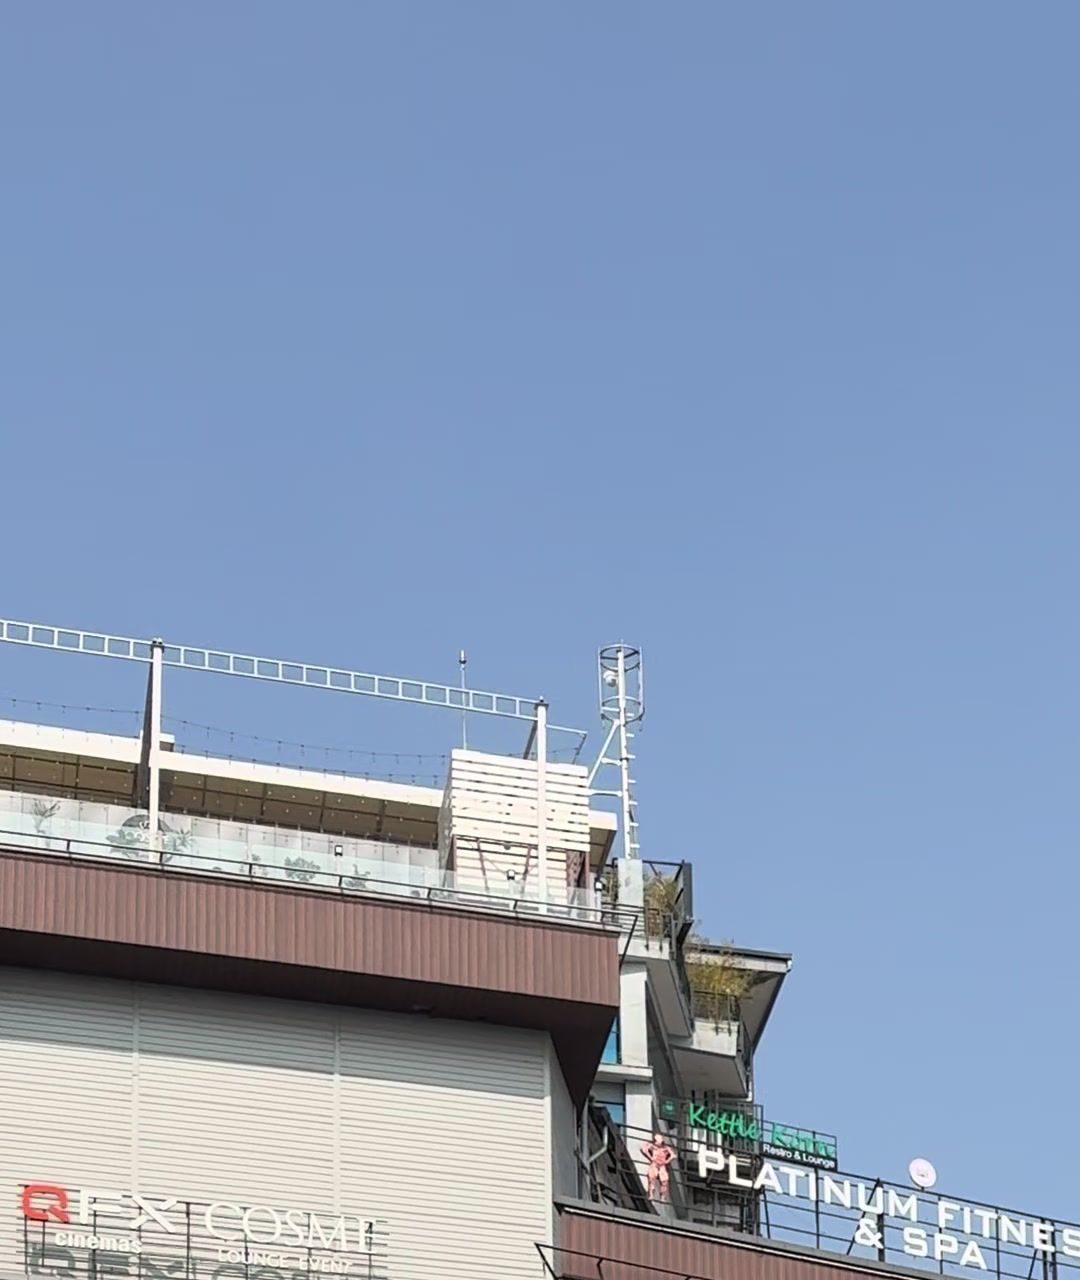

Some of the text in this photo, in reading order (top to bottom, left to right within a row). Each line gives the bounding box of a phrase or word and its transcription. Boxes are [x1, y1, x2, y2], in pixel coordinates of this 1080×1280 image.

[689, 1102, 761, 1140] Kettle
[794, 1151, 801, 1160] &
[803, 1153, 835, 1168] Lounge
[698, 1150, 918, 1222] PLATINUM
[22, 1184, 177, 1232] QFX
[55, 1231, 142, 1253] cinemas
[218, 1249, 352, 1273] LOUNGE EVENT
[855, 1218, 988, 1270] & SPA
